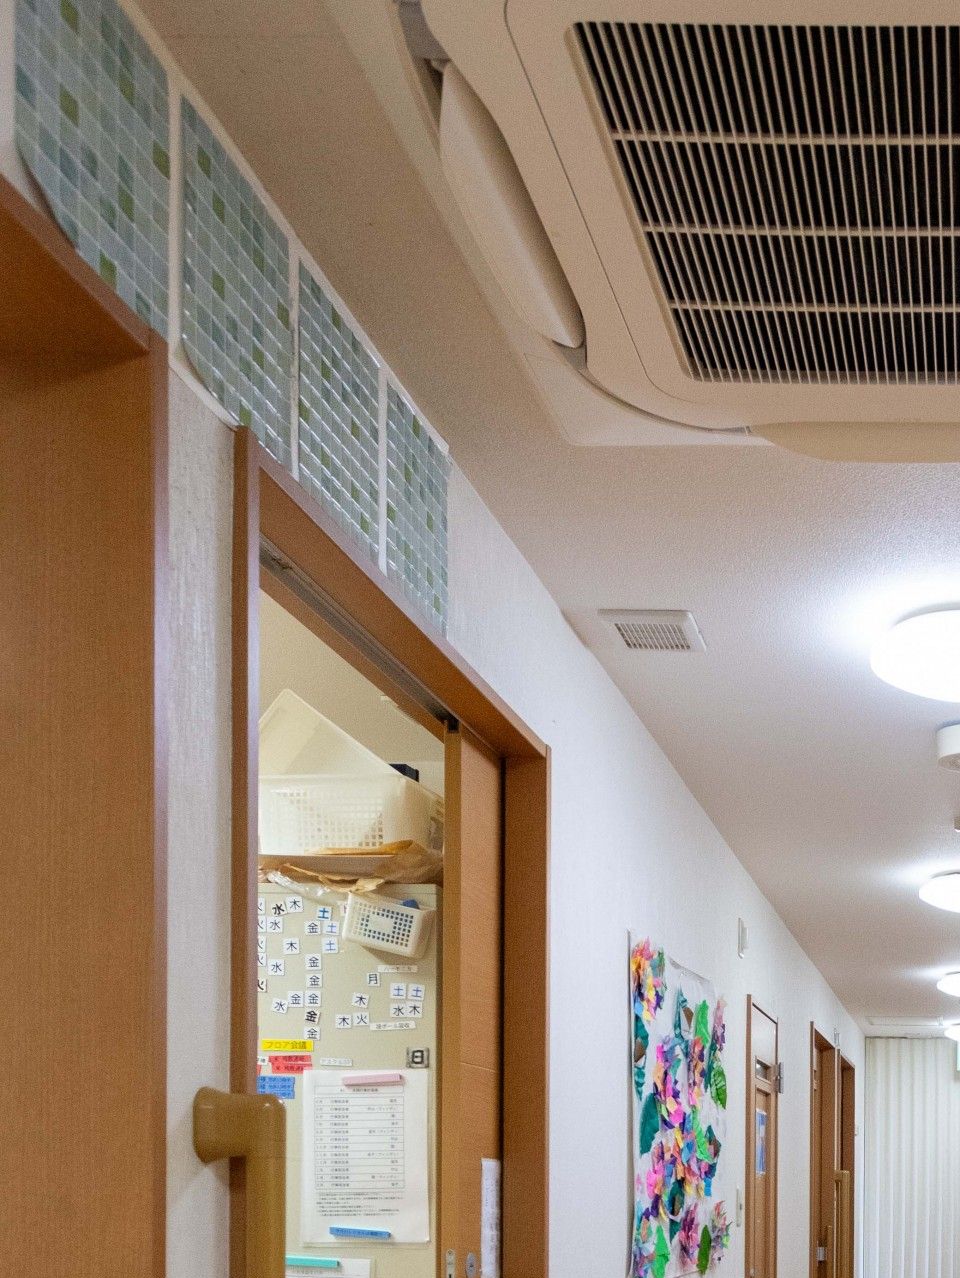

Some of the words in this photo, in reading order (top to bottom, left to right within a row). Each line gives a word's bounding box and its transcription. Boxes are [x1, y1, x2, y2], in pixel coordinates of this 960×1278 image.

[272, 903, 285, 916] 水
[289, 899, 301, 910] 木
[317, 907, 329, 919] 土
[269, 919, 280, 931] 水
[307, 922, 318, 934] 金
[326, 922, 337, 934] 土
[286, 940, 297, 952] 木
[325, 940, 336, 951] 土
[271, 962, 282, 973] 水
[308, 956, 319, 968] 金
[309, 975, 320, 986] 金
[368, 973, 378, 985] 月
[393, 985, 404, 997] 土
[411, 986, 422, 998] 土
[290, 993, 301, 1005] 金
[308, 993, 319, 1005] 金
[355, 995, 366, 1006] 木
[274, 1000, 285, 1012] 水
[393, 1005, 404, 1017] 水
[408, 1004, 420, 1016] 木
[305, 1010, 318, 1023] 金
[338, 1016, 349, 1027] 木
[356, 1013, 367, 1025] 火
[307, 1028, 318, 1039] 金
[411, 1049, 424, 1065] 日
